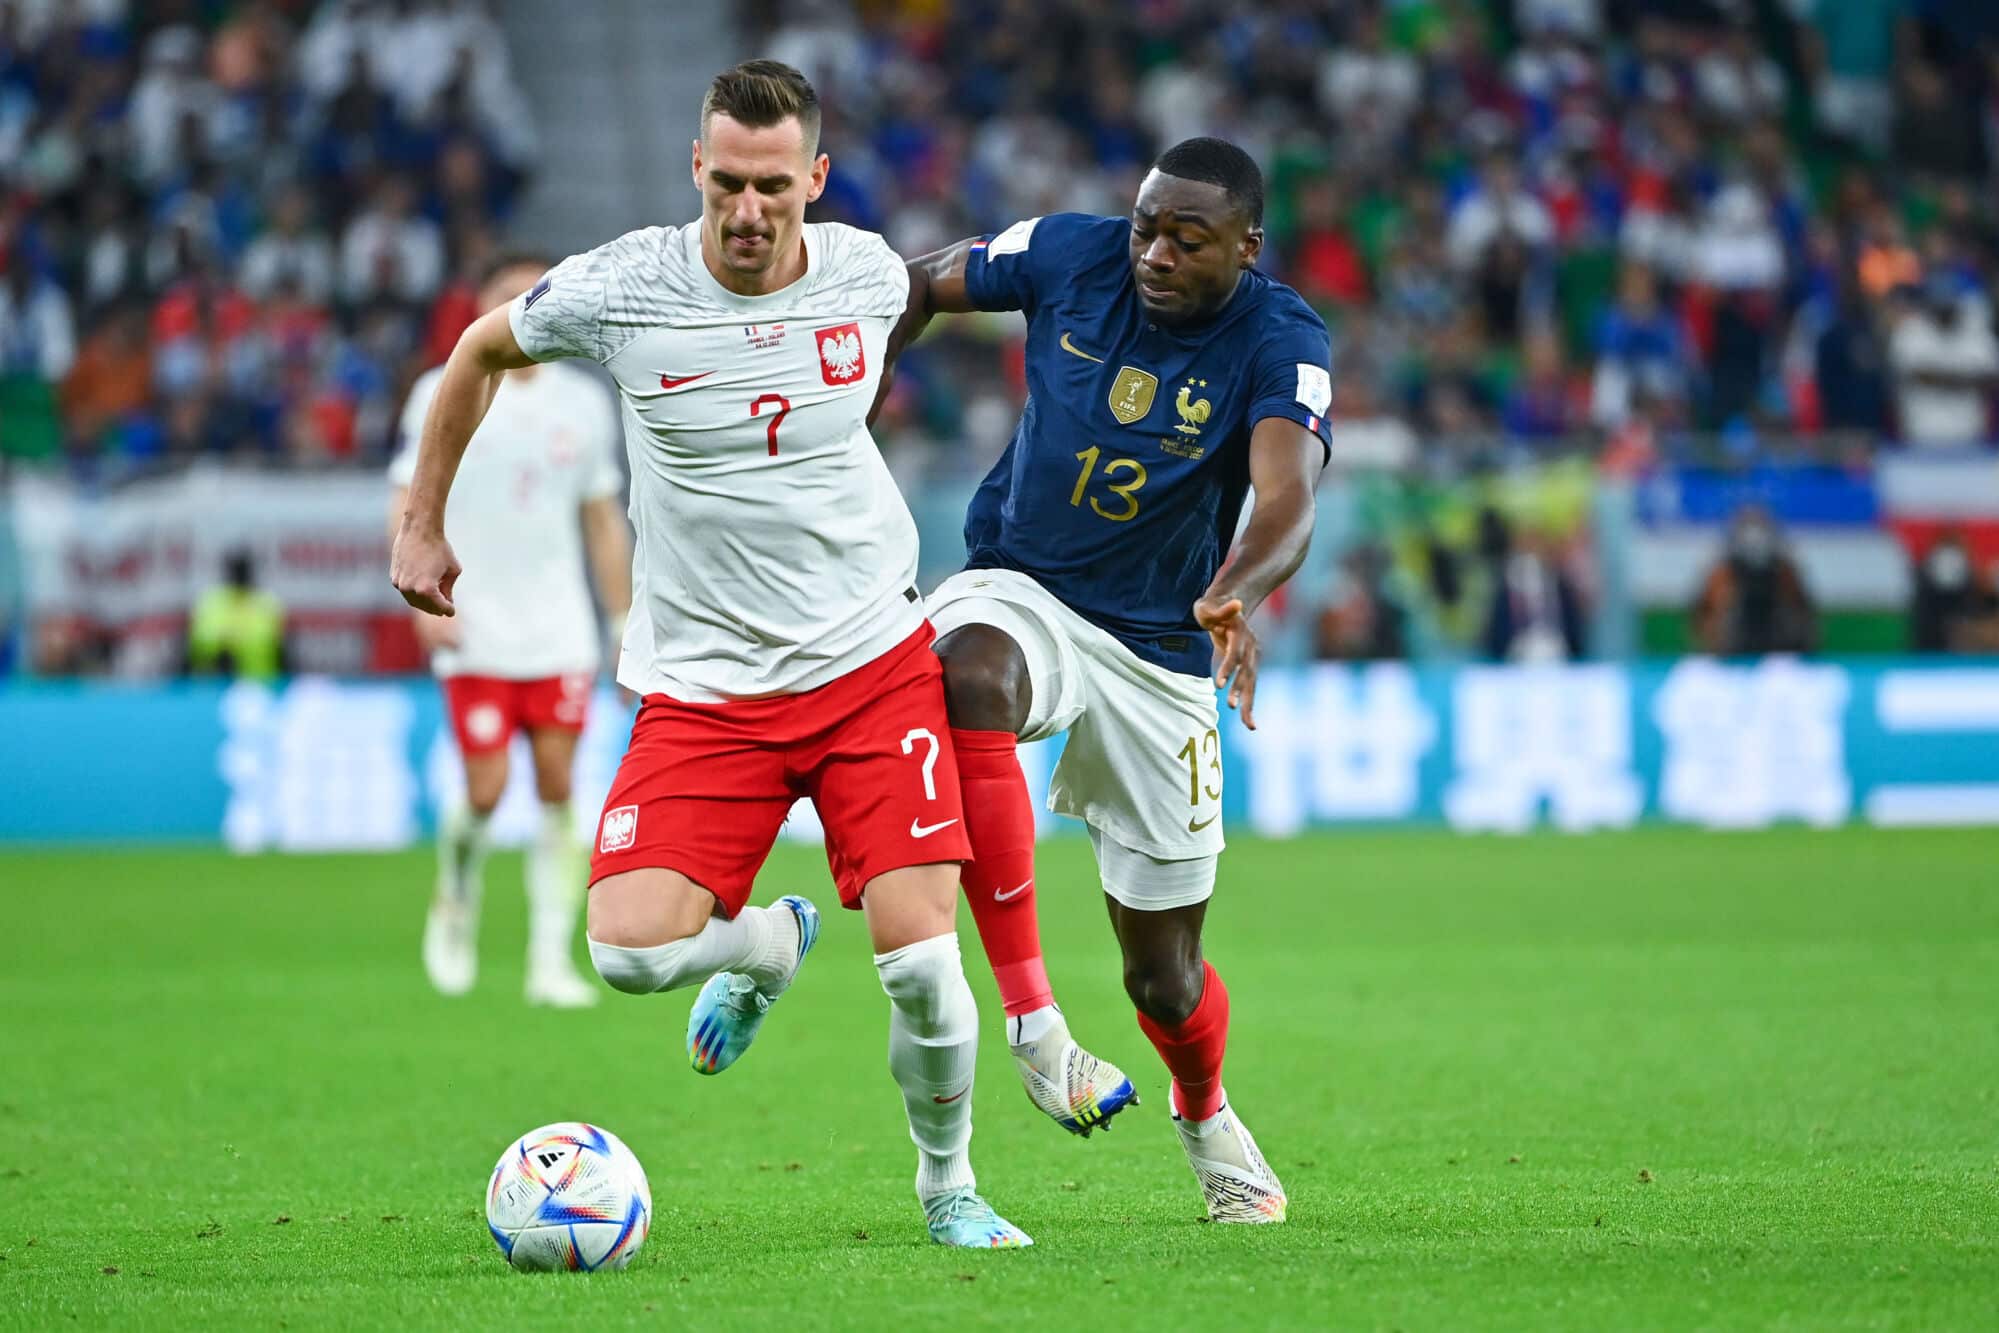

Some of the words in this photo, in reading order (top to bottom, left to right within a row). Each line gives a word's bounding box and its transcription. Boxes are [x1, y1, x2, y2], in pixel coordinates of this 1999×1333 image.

[750, 394, 790, 456] 7
[1119, 401, 1137, 412] FIFA
[1070, 445, 1147, 521] 13
[900, 727, 939, 801] 7
[1177, 728, 1222, 807] 13
